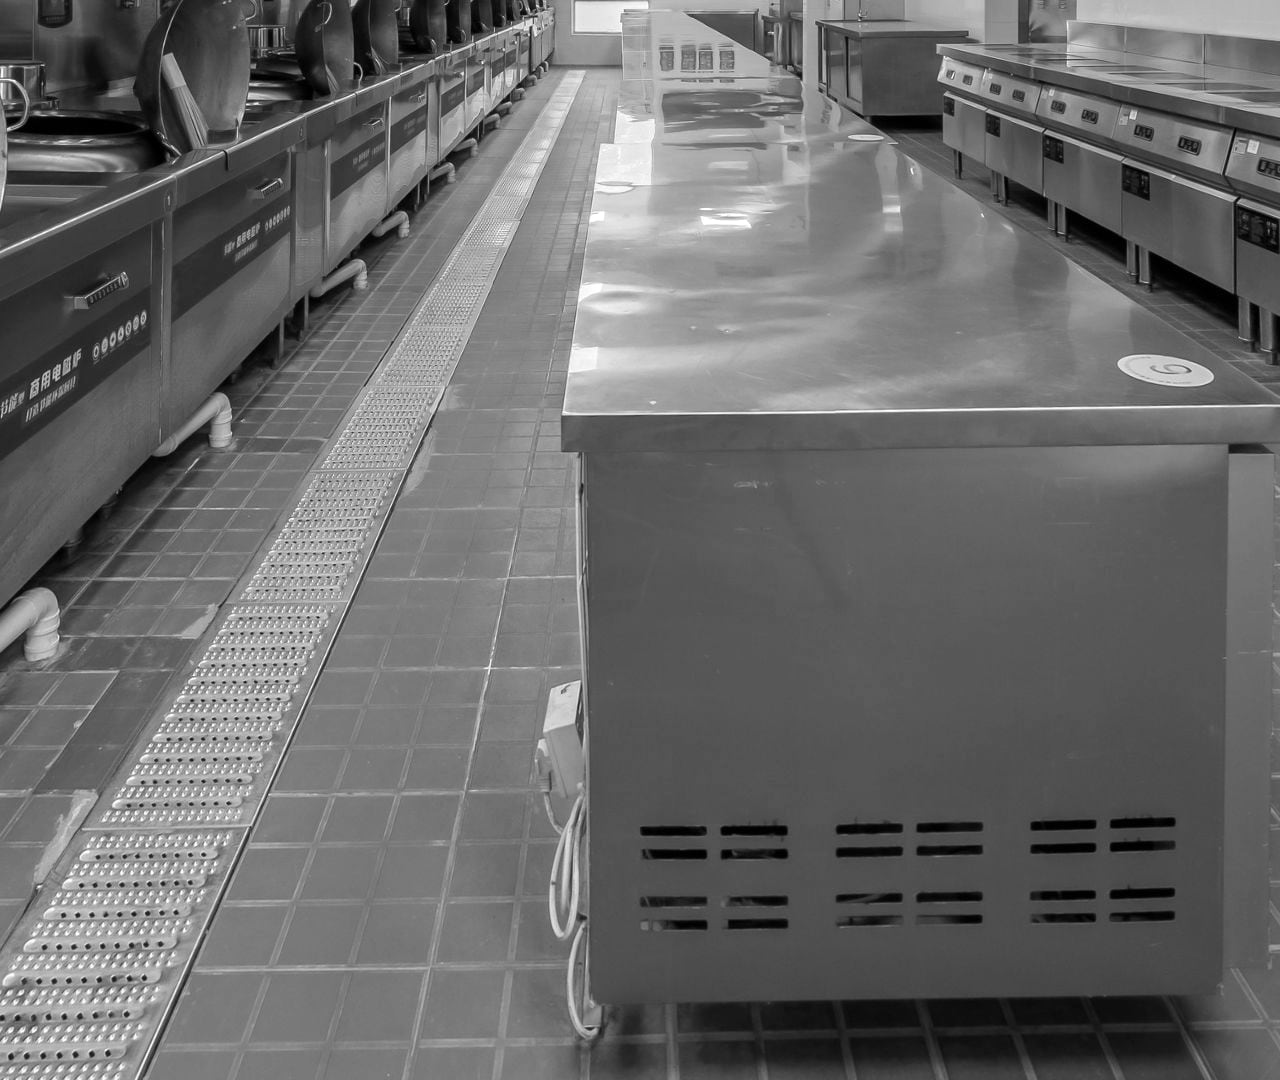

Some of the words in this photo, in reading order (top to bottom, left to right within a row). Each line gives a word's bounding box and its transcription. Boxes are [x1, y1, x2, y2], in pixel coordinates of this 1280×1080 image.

[29, 348, 82, 400] 商用电磁炉
